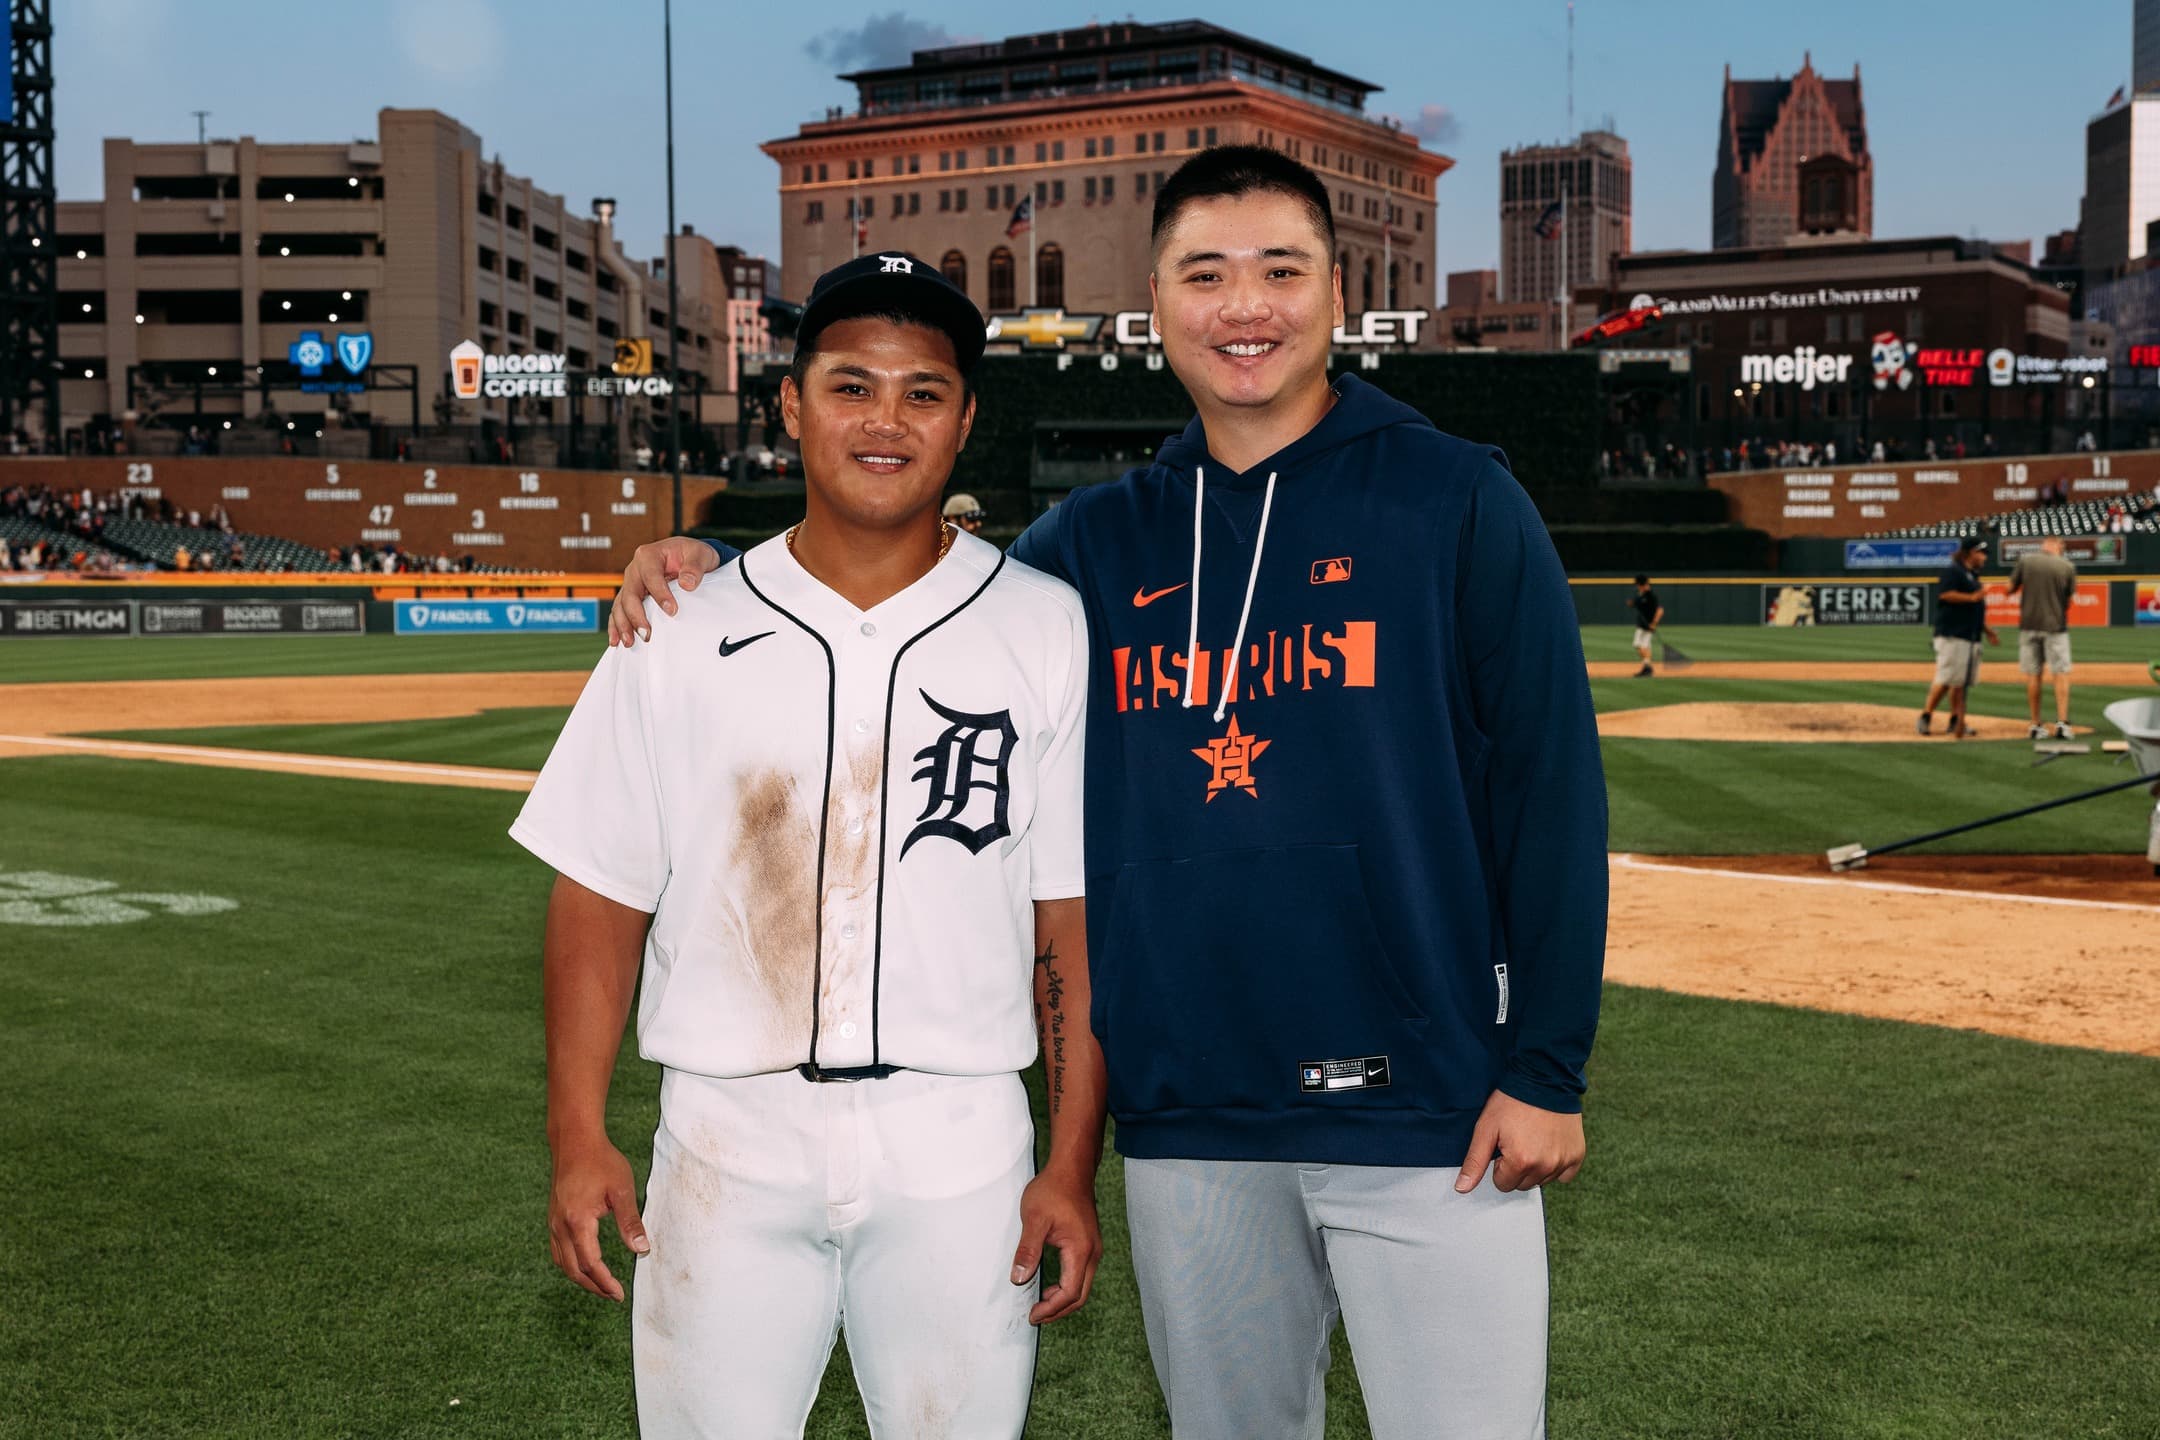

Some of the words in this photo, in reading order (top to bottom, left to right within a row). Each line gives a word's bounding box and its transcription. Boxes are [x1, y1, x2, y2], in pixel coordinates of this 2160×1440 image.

[1711, 294, 1768, 311] VALLEY
[1818, 287, 1921, 306] UNIVERSITY
[484, 354, 566, 373] BIGGBY
[1741, 346, 1853, 391] meijer
[1917, 349, 1984, 367] BELLE
[484, 378, 567, 398] COFFEE
[1924, 368, 1974, 386] TIRE
[127, 463, 153, 484] 23
[326, 464, 340, 485] 5
[2005, 463, 2029, 485] 10
[2092, 456, 2111, 478] 11
[423, 468, 438, 490] 2
[519, 472, 540, 493] 16
[621, 477, 636, 498] 6
[368, 504, 394, 526] 47
[471, 508, 486, 530] 3
[581, 511, 591, 533] 1
[1819, 587, 1921, 611] FERRIS
[34, 609, 126, 630] BETMGM
[430, 608, 494, 625] FANDUEL
[526, 608, 587, 624] FANDUEL
[1820, 611, 1850, 622] STATE
[1853, 611, 1919, 622] UNIVERSITY
[1112, 622, 1374, 713] ASTROS
[900, 687, 1020, 863] D
[1046, 970, 1064, 1011] May
[1052, 1011, 1065, 1035] the
[1326, 1061, 1362, 1069] ENGINEERED
[1054, 1066, 1066, 1094] lead
